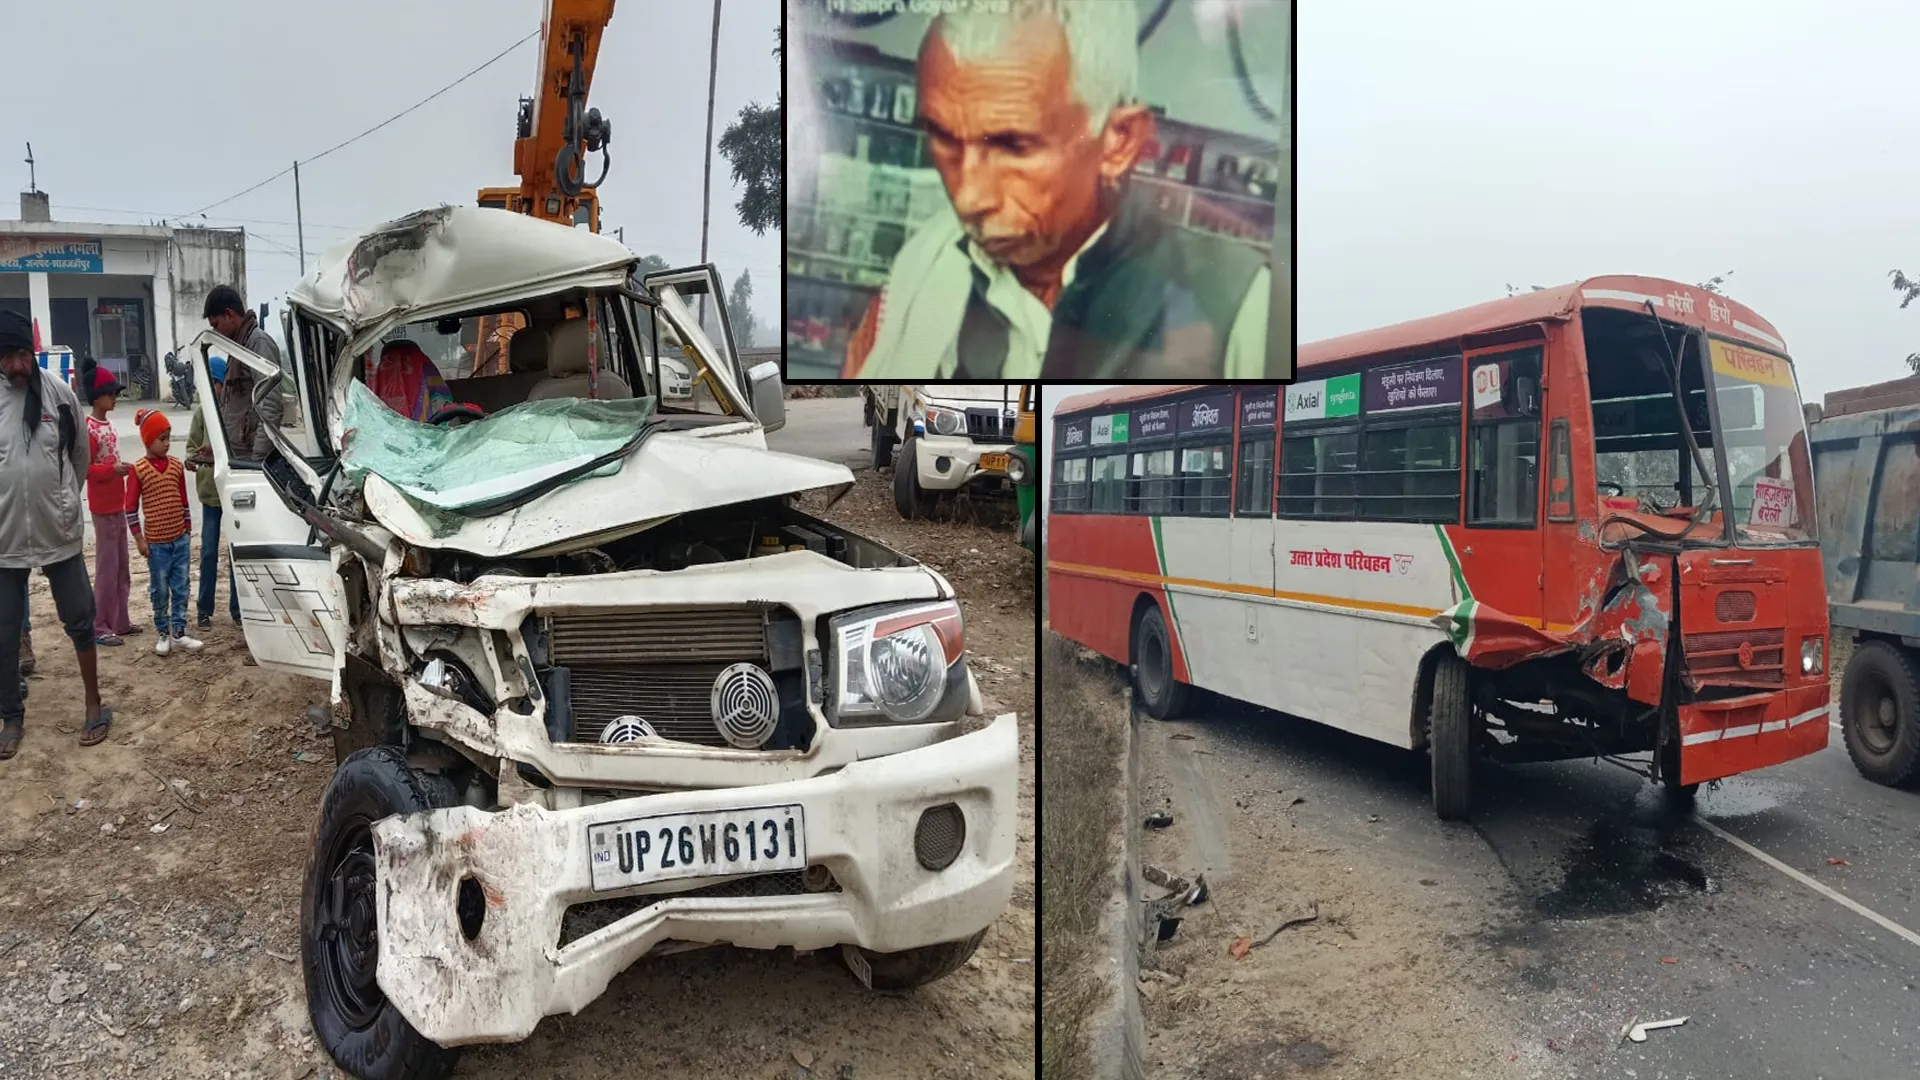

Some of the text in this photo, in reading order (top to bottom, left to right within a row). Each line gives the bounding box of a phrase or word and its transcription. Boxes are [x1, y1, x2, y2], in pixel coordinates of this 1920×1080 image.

[1666, 290, 1731, 325] बरेली डिपो
[1720, 346, 1776, 379] परिवहन
[1297, 390, 1320, 410] Axial
[1758, 501, 1782, 523] बरेली
[1289, 548, 1392, 574] उत्तर प्रदेश परिवहन
[594, 850, 611, 863] IND
